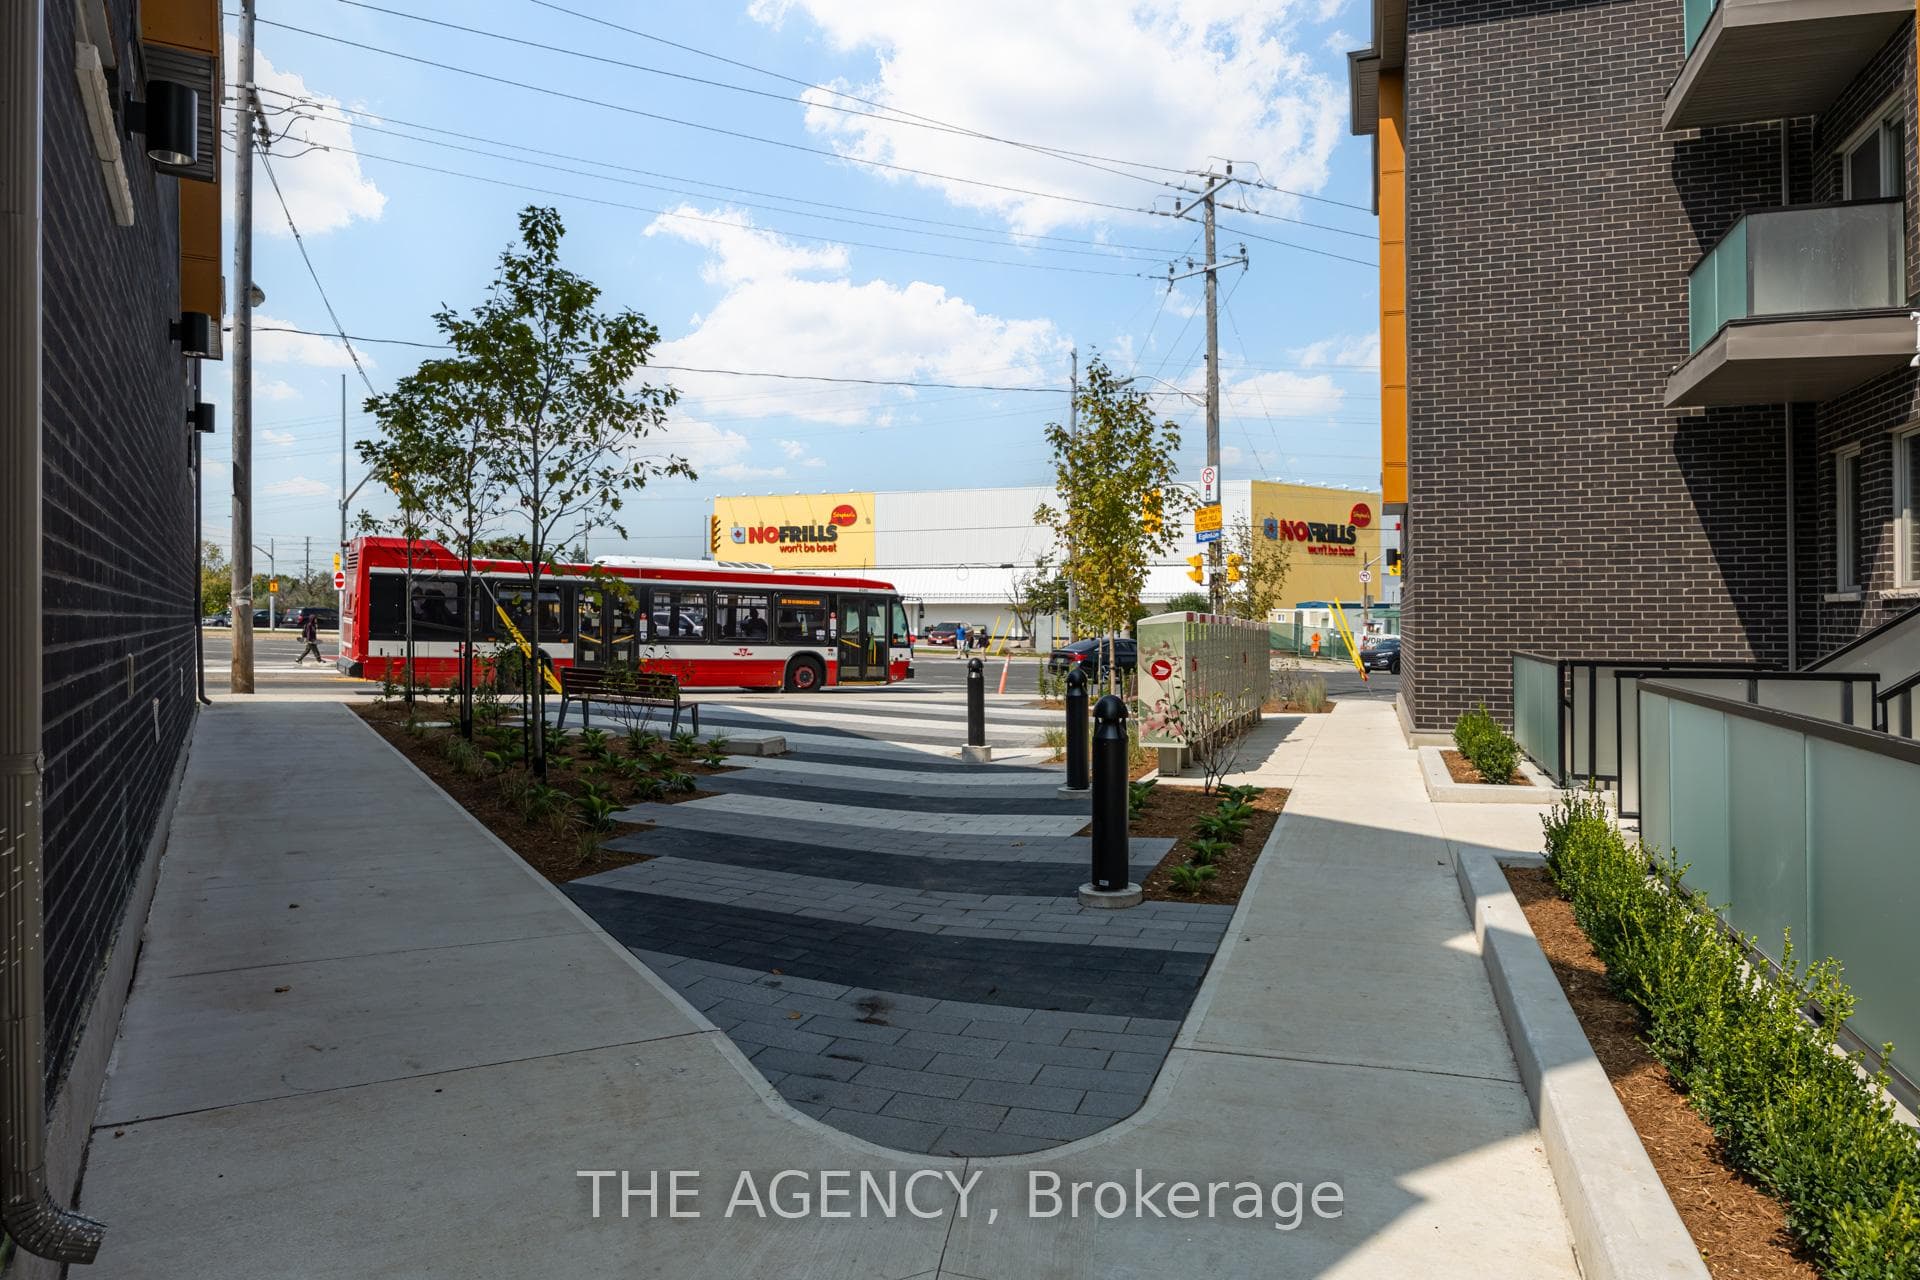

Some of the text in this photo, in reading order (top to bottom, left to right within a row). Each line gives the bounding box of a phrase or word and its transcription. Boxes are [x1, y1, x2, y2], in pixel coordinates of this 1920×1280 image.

[780, 543, 837, 553] won't be beat
[1307, 545, 1355, 556] won't be beat
